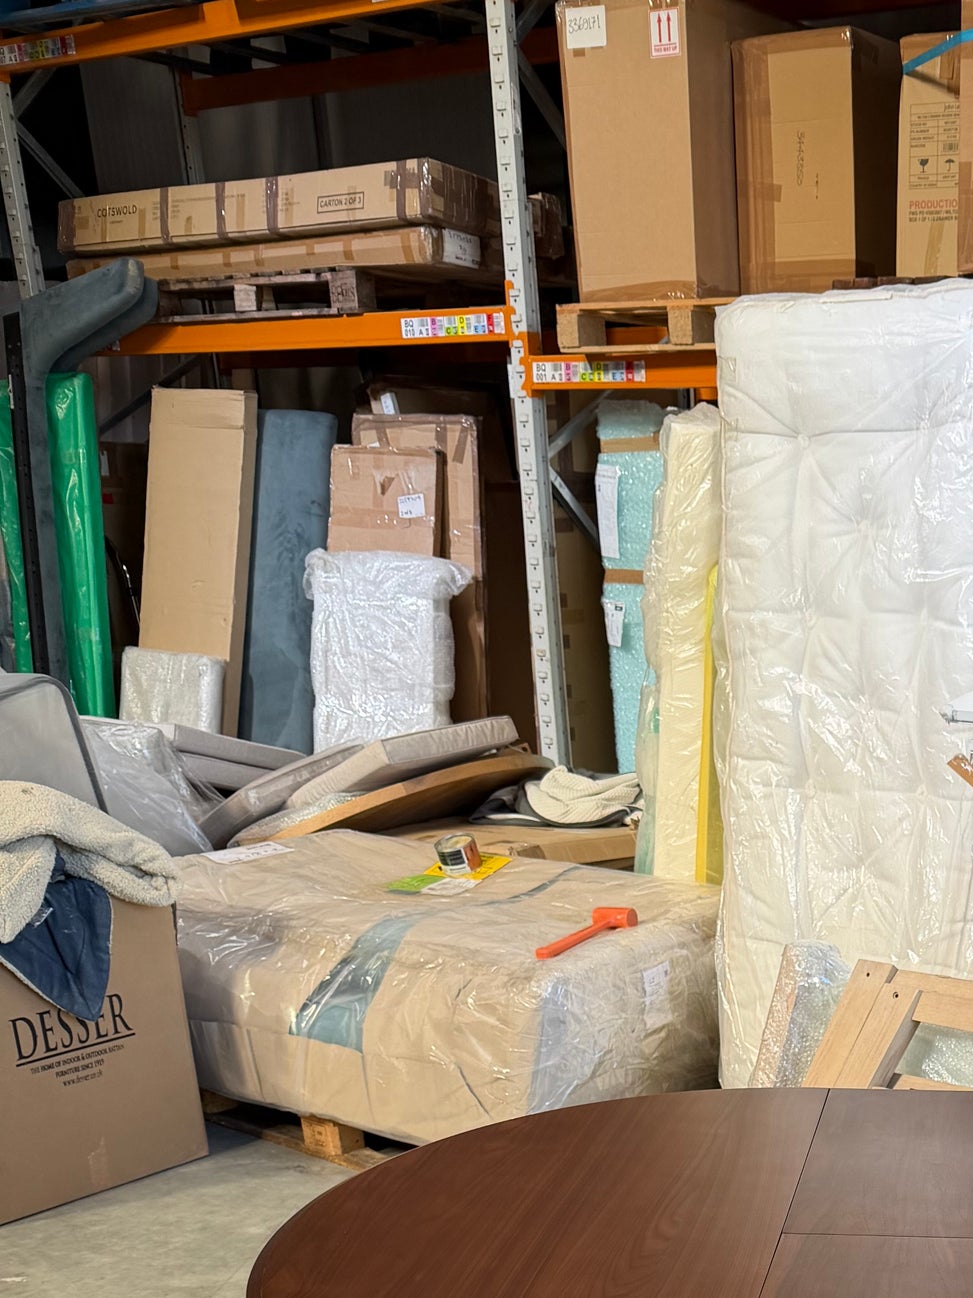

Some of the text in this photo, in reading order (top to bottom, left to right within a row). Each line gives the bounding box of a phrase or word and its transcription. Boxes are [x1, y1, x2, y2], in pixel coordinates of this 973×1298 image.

[97, 204, 138, 218] COTSWOLD
[319, 198, 342, 208] CARTON
[8, 993, 134, 1061] DESSER
[62, 1056, 81, 1067] INDOOR
[86, 1049, 108, 1060] OUTDOOR
